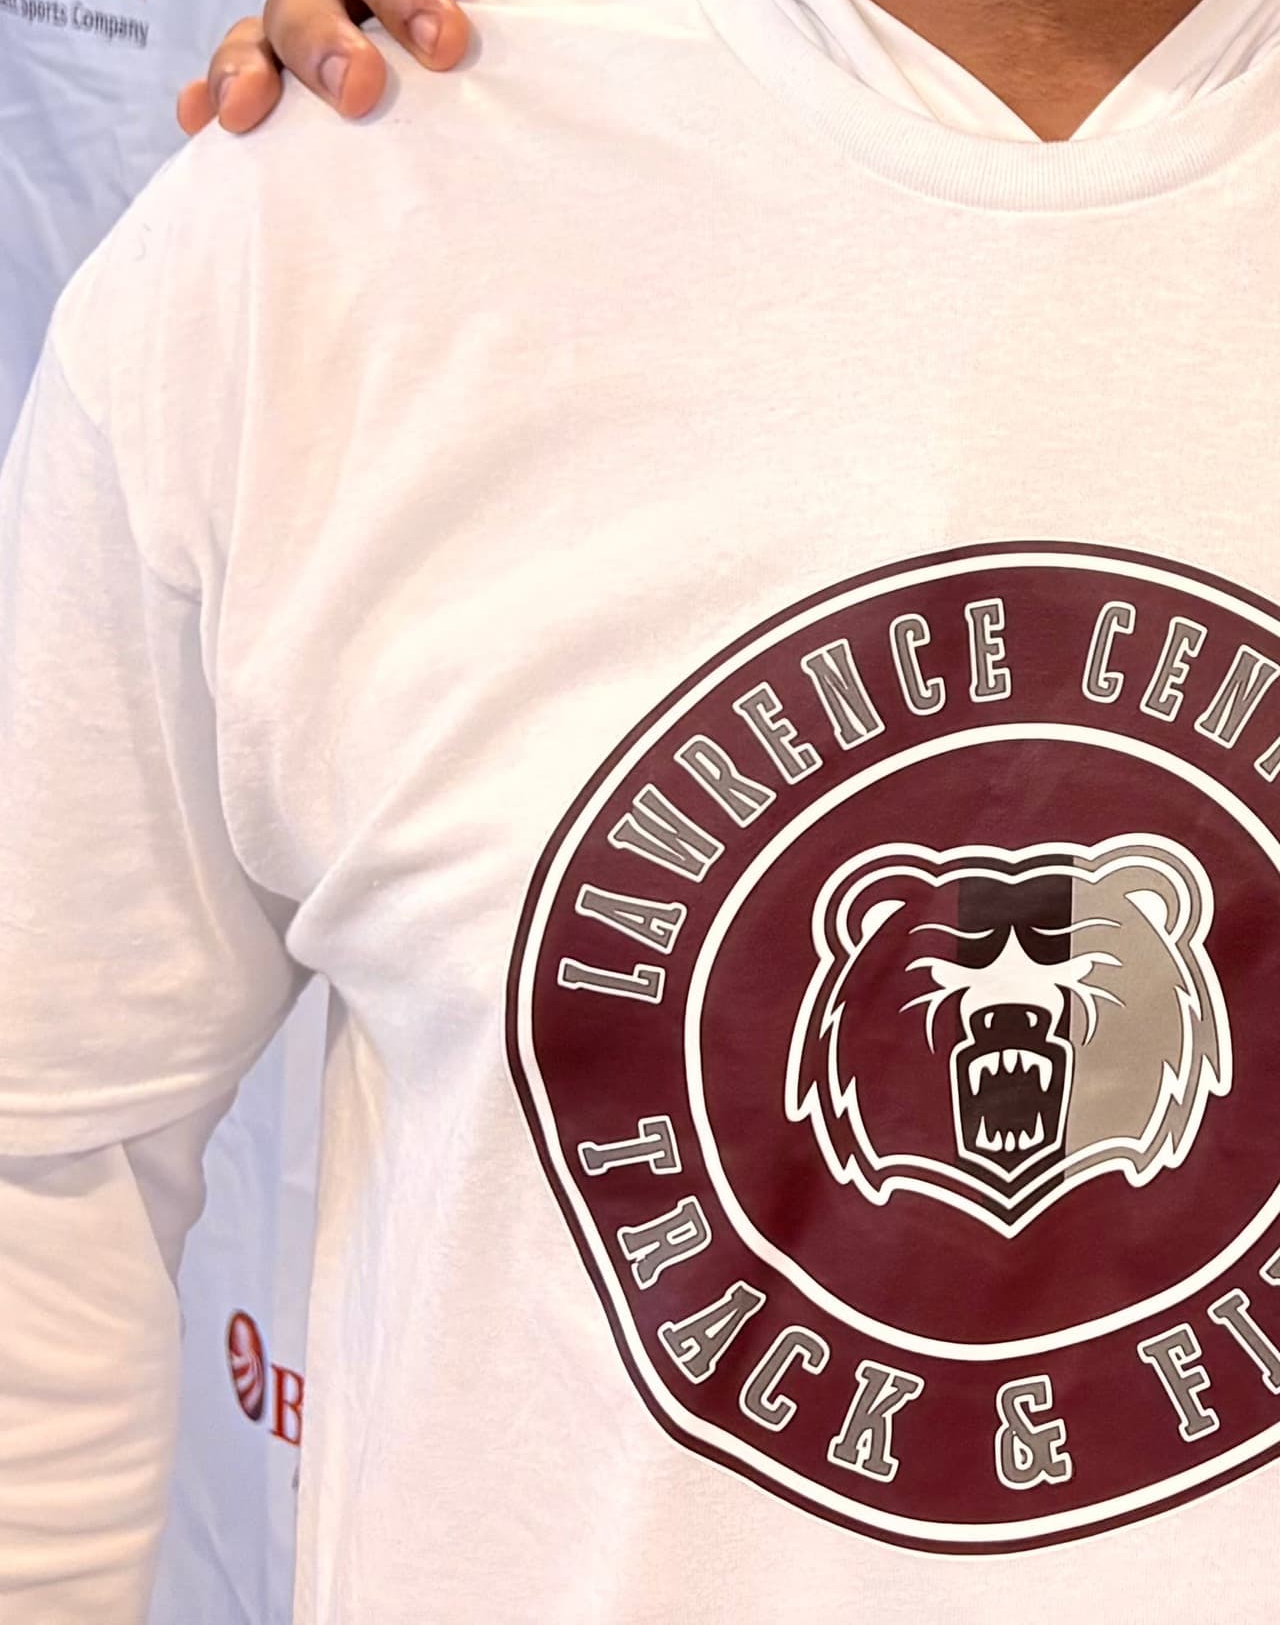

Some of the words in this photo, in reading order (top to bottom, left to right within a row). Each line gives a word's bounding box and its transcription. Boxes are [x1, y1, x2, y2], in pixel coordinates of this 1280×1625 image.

[71, 0, 149, 48] Company
[557, 596, 1013, 1004] LAWRENCE
[575, 1113, 925, 1483] TRACK
[993, 1374, 1073, 1491] &
